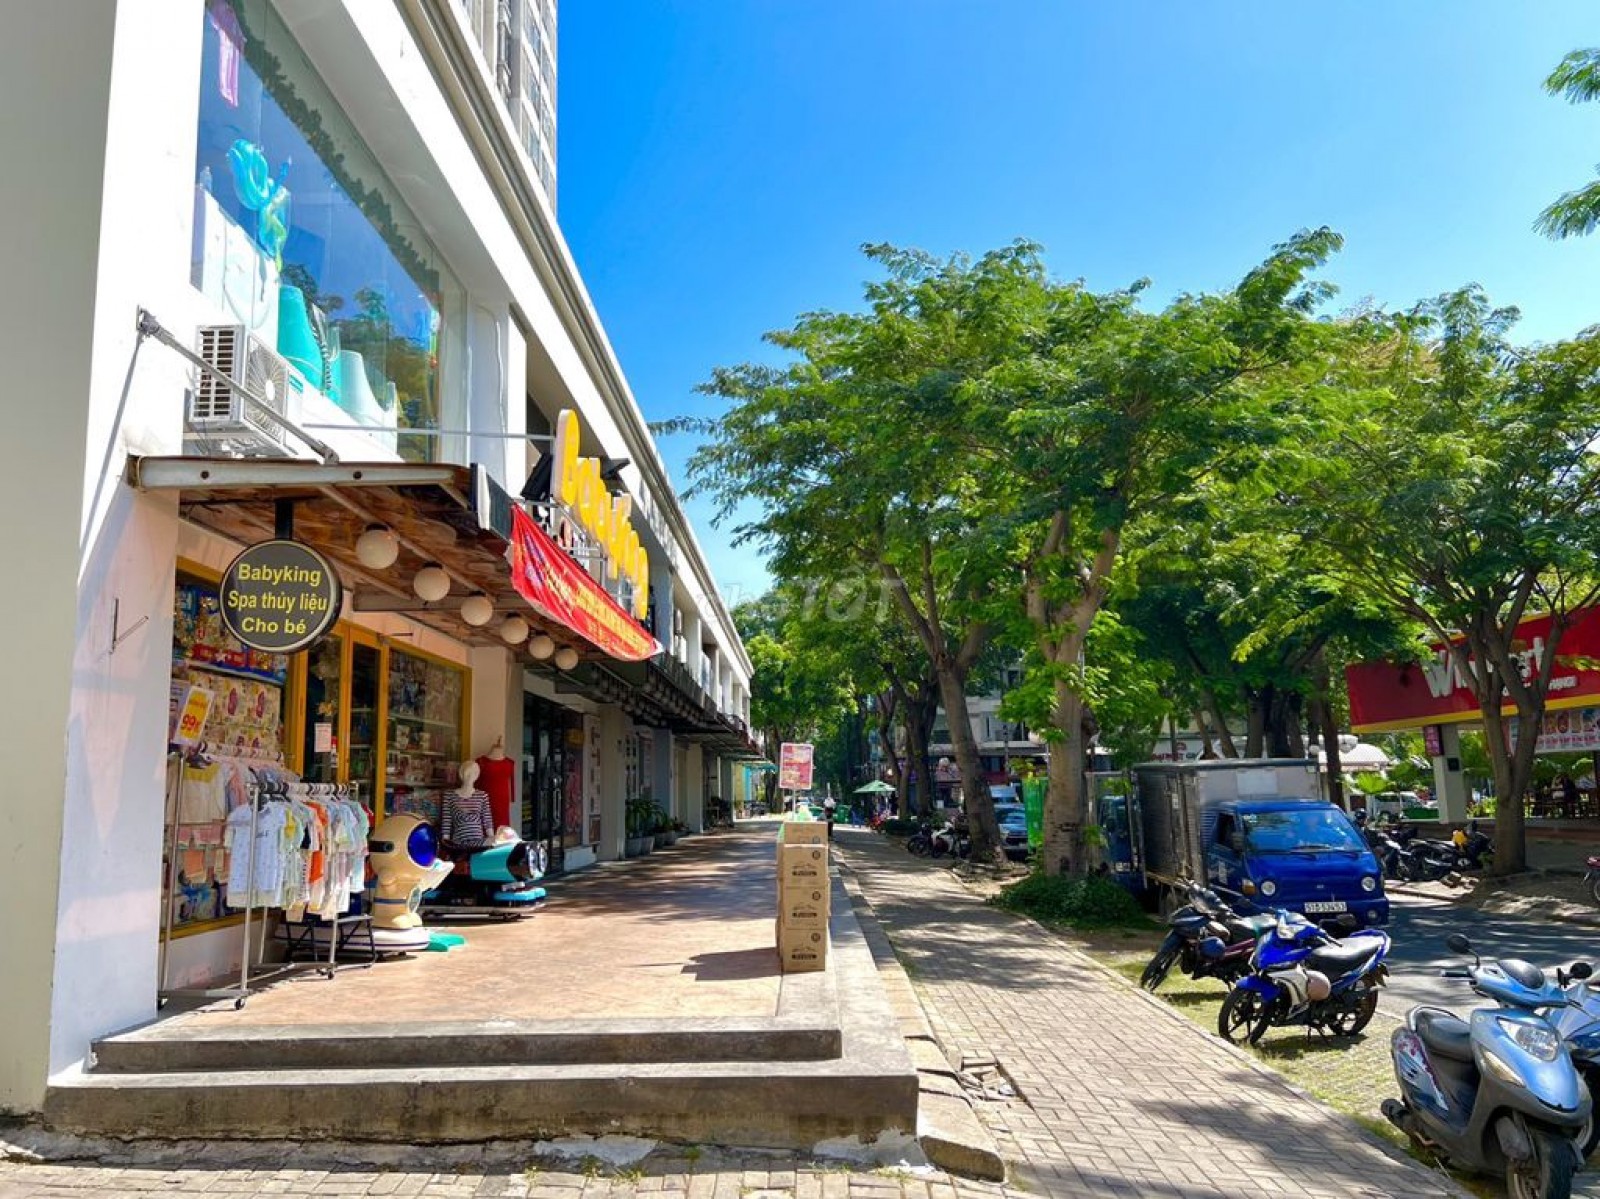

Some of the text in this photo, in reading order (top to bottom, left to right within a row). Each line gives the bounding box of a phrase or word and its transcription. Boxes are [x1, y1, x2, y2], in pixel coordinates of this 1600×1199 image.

[238, 563, 321, 587] Babyking
[228, 590, 327, 615] Spa thủy liệu
[241, 617, 307, 634] Cho bé
